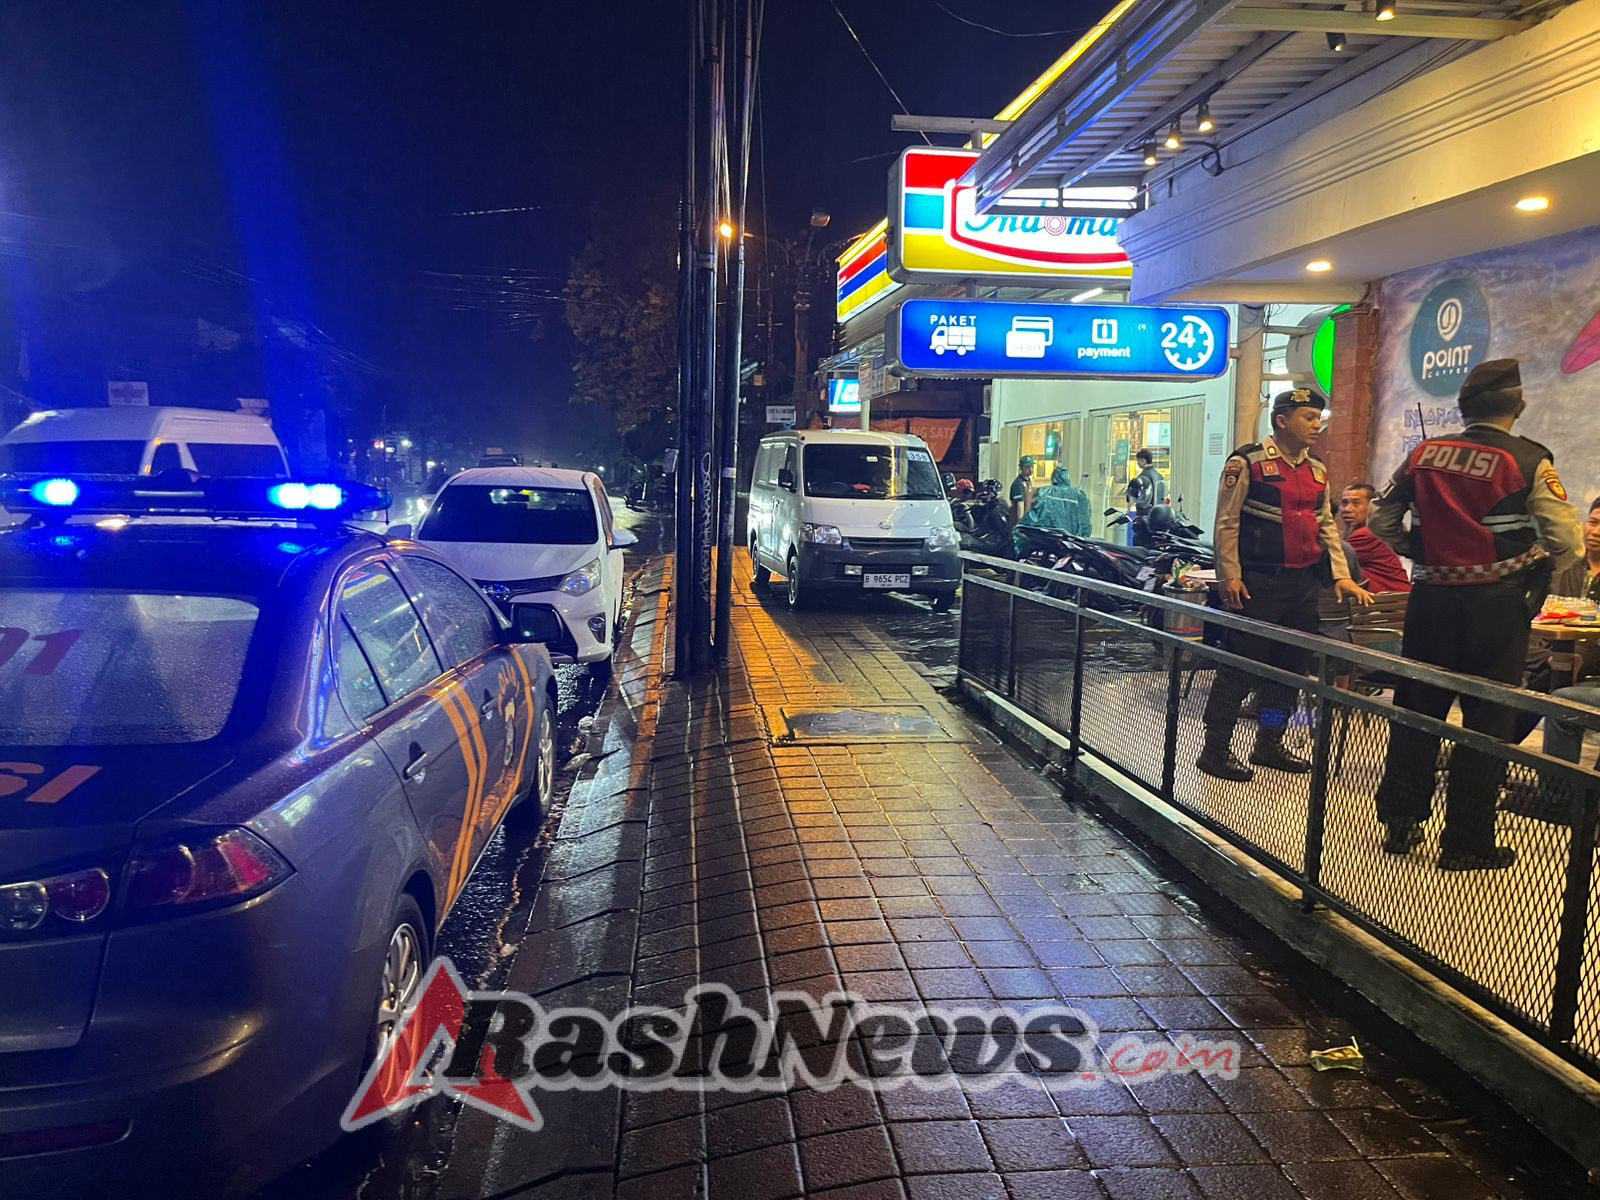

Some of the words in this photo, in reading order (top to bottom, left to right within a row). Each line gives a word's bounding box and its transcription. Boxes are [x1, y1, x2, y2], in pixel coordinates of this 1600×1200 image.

[930, 315, 976, 326] PAKET
[1161, 322, 1196, 348] 24
[1077, 346, 1131, 358] payment
[1416, 445, 1500, 478] POLISI
[873, 575, 892, 583] 9654
